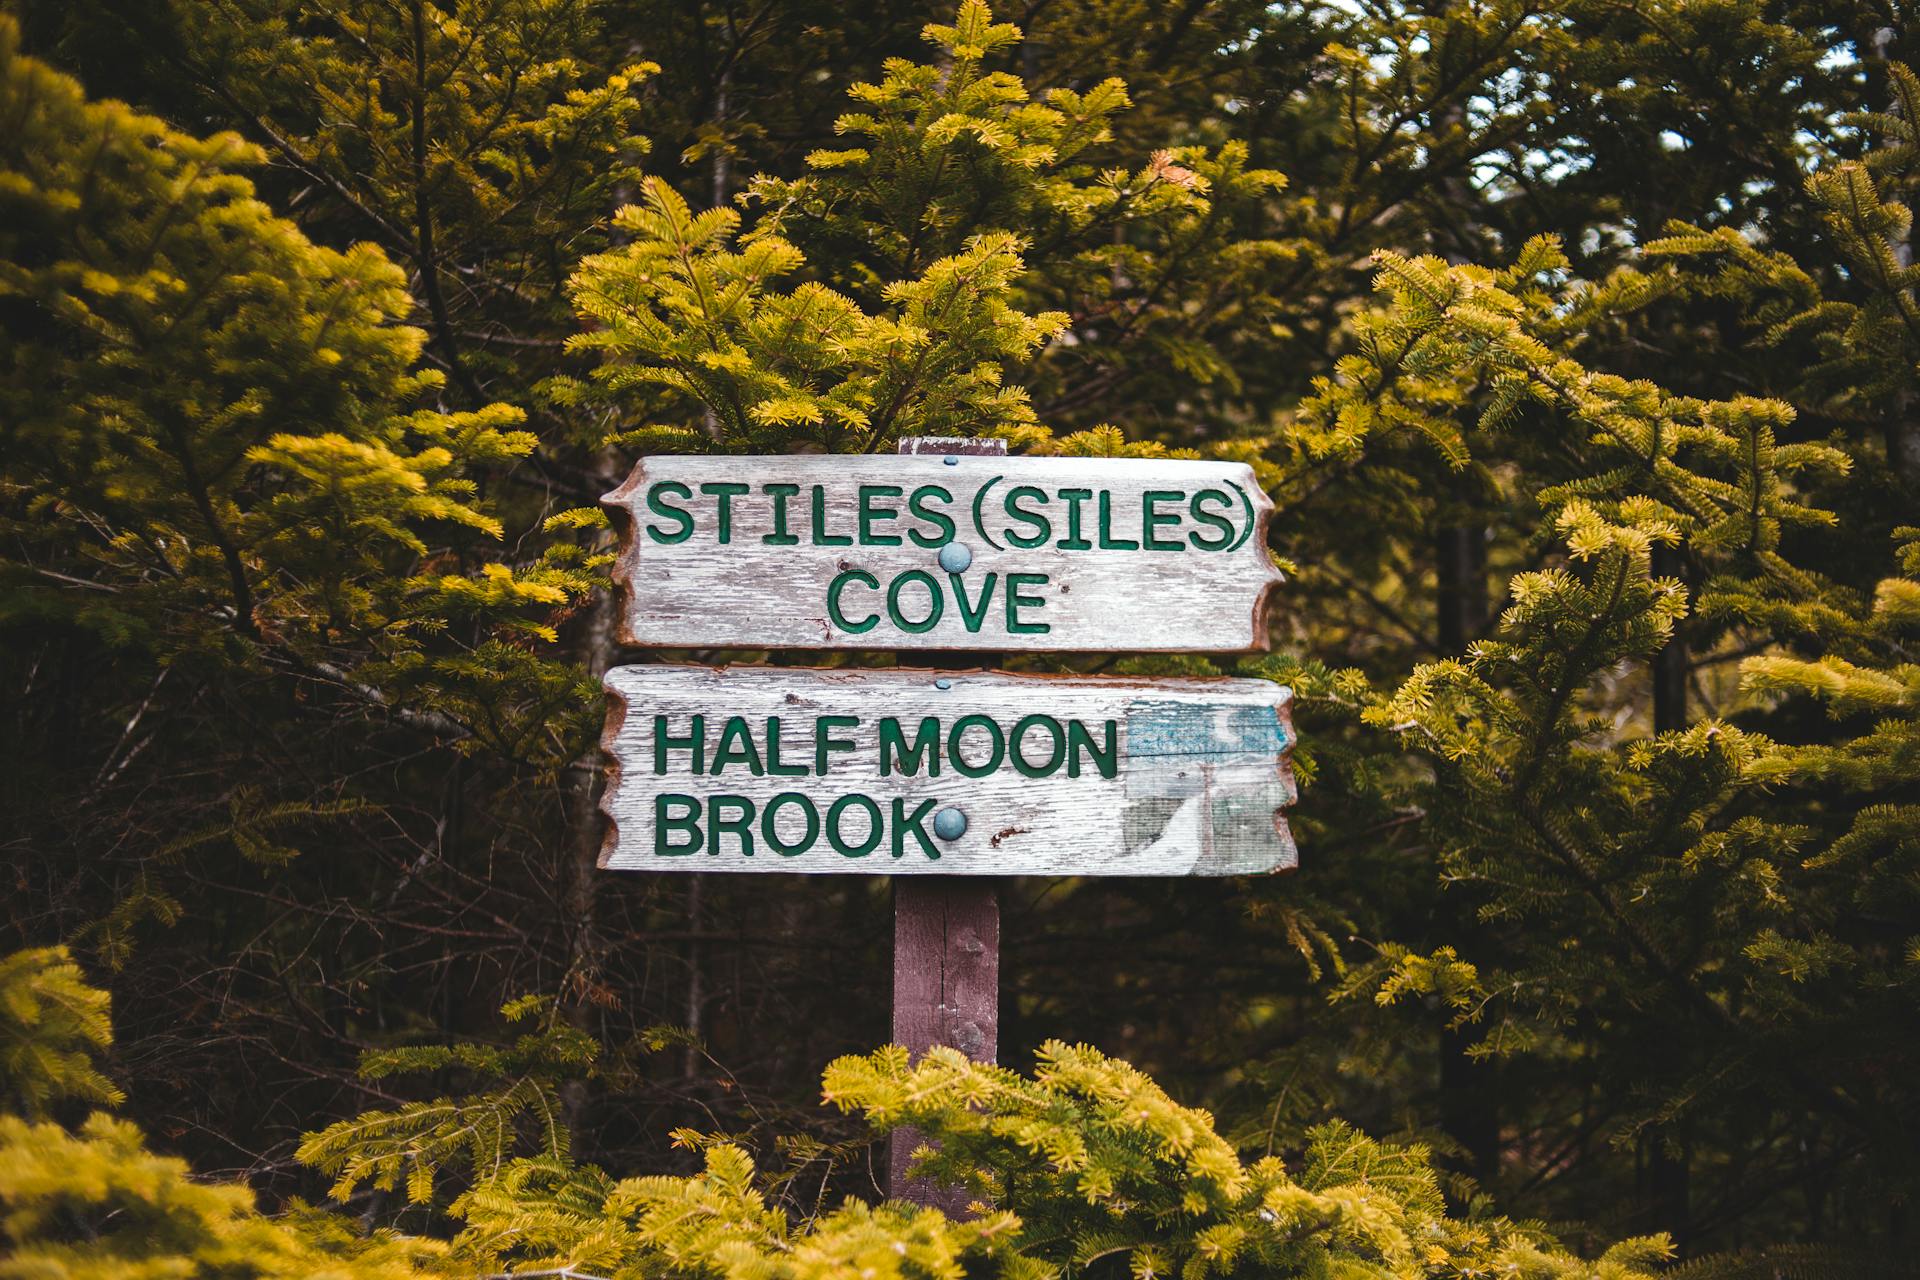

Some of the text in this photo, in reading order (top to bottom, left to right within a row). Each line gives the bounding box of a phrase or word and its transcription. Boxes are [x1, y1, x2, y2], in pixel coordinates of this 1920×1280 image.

[646, 475, 1256, 553] STILES (SILES)
[827, 569, 1051, 634] COVE
[654, 713, 1118, 779] HALF MOON
[655, 792, 942, 860] BROOK
